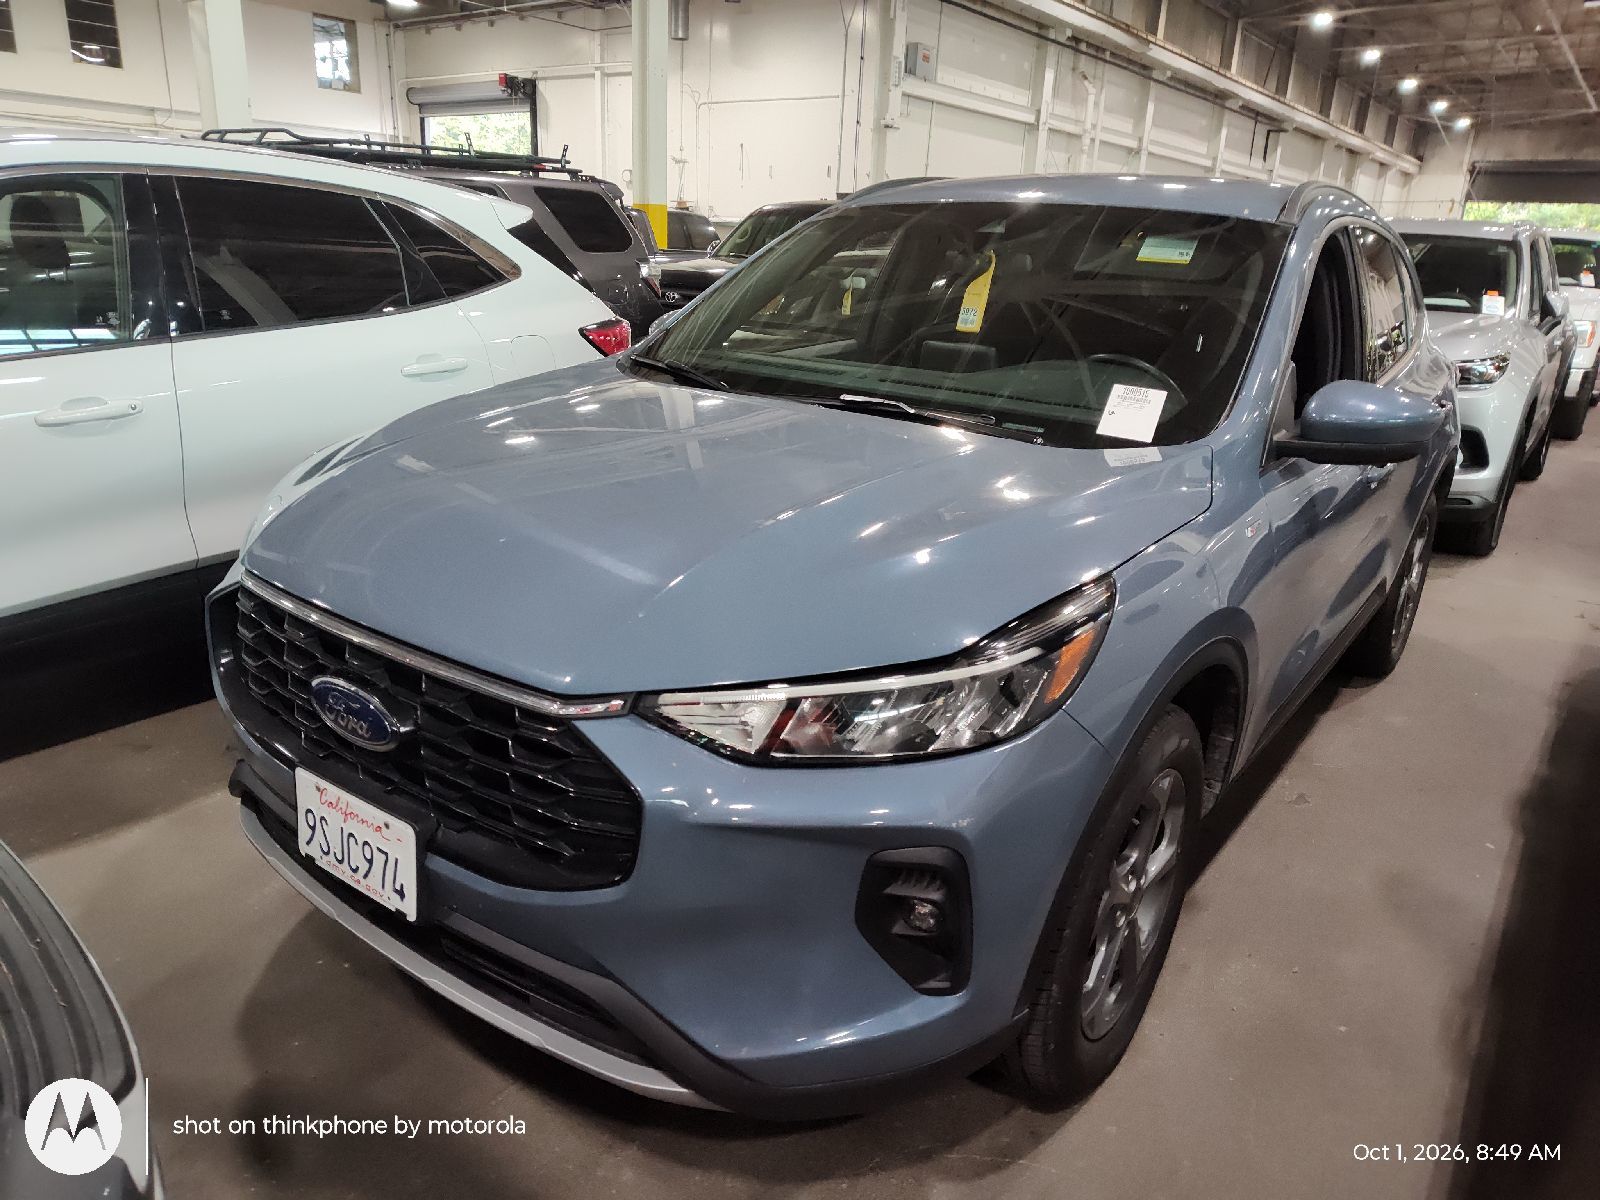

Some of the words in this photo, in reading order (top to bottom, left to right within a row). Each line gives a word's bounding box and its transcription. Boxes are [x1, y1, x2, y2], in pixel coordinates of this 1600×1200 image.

[325, 692, 372, 738] Ford
[319, 787, 391, 842] California
[304, 808, 406, 902] 9SJC974
[325, 859, 385, 898] dmv.ca.gov
